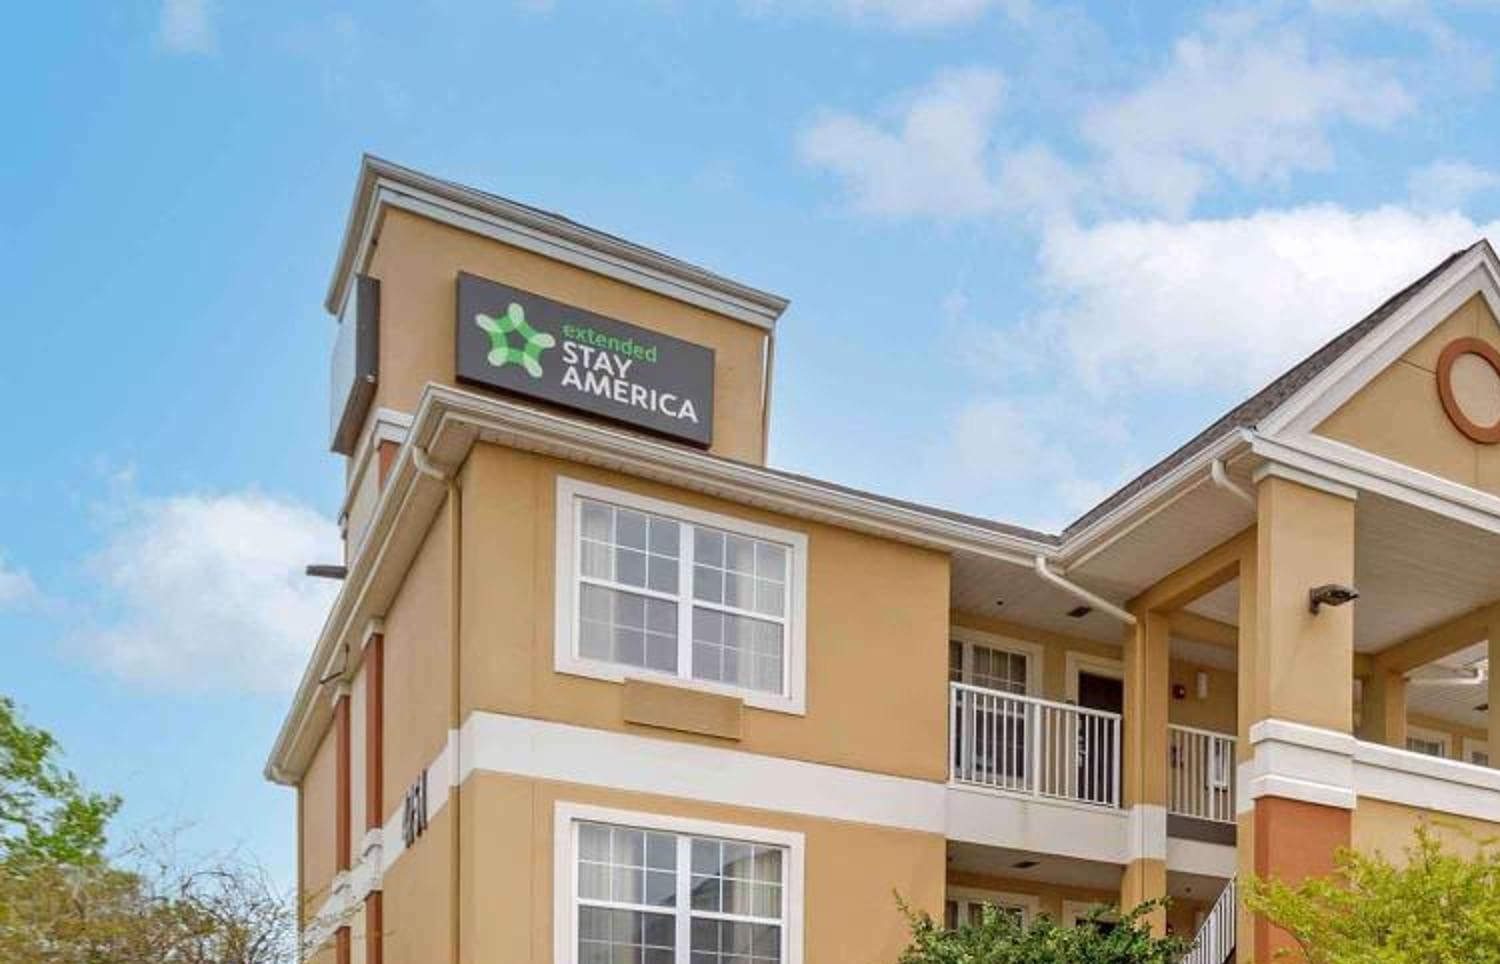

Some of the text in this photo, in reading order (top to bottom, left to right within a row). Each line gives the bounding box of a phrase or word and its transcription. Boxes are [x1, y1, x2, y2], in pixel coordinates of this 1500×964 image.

[562, 324, 657, 363] extended
[562, 341, 633, 379] STAY
[561, 366, 699, 424] AMERICA
